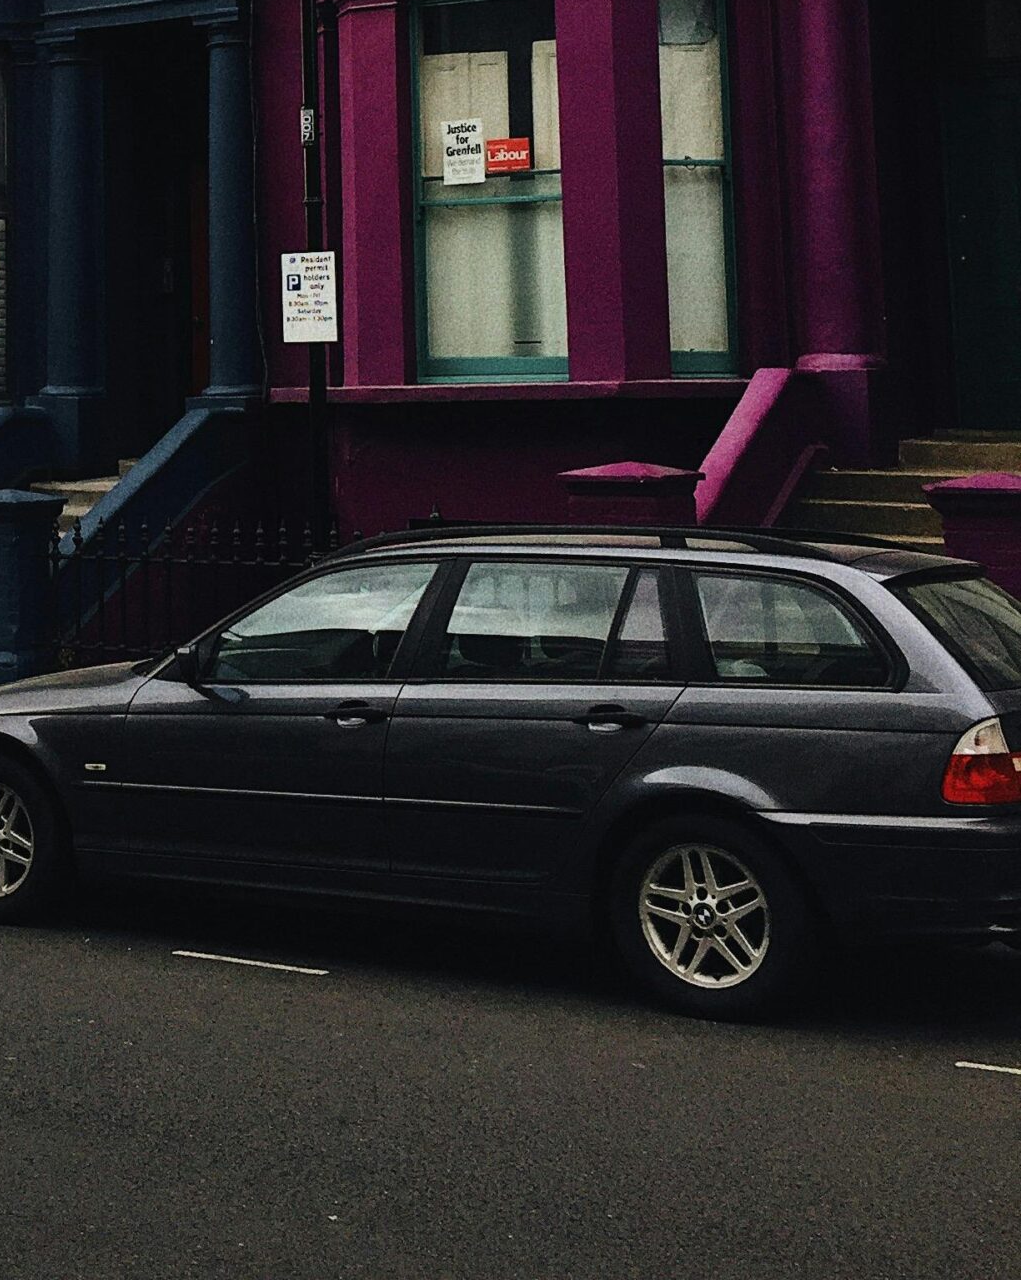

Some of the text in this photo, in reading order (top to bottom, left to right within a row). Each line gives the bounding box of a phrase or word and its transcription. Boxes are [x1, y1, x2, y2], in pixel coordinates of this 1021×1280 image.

[447, 123, 477, 134] Justice
[456, 134, 469, 144] for
[446, 144, 481, 157] Grenfell
[487, 149, 529, 162] Labour
[289, 276, 299, 290] P
